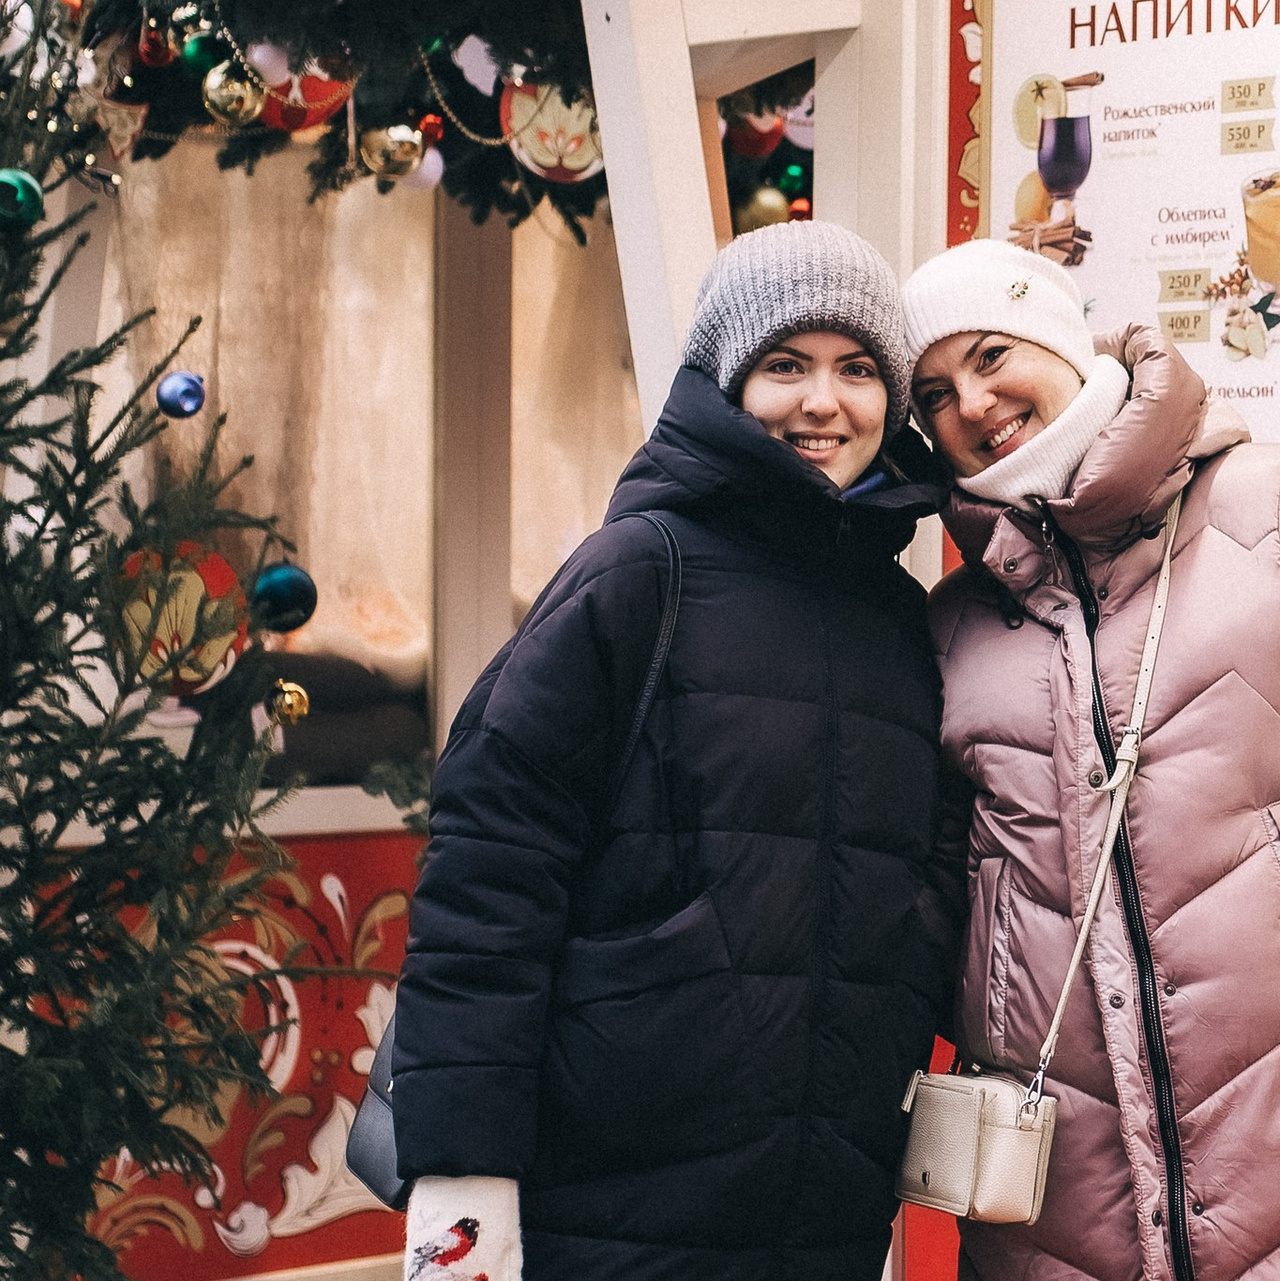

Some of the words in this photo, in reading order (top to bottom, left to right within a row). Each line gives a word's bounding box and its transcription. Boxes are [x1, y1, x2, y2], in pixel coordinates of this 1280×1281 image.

[1228, 84, 1251, 100] 350
[1103, 96, 1216, 121] Рождественский
[1227, 126, 1251, 141] 550
[1158, 207, 1227, 224] Облепиха
[1151, 234, 1157, 246] с
[1168, 274, 1191, 290] 250
[1167, 316, 1190, 330] 400
